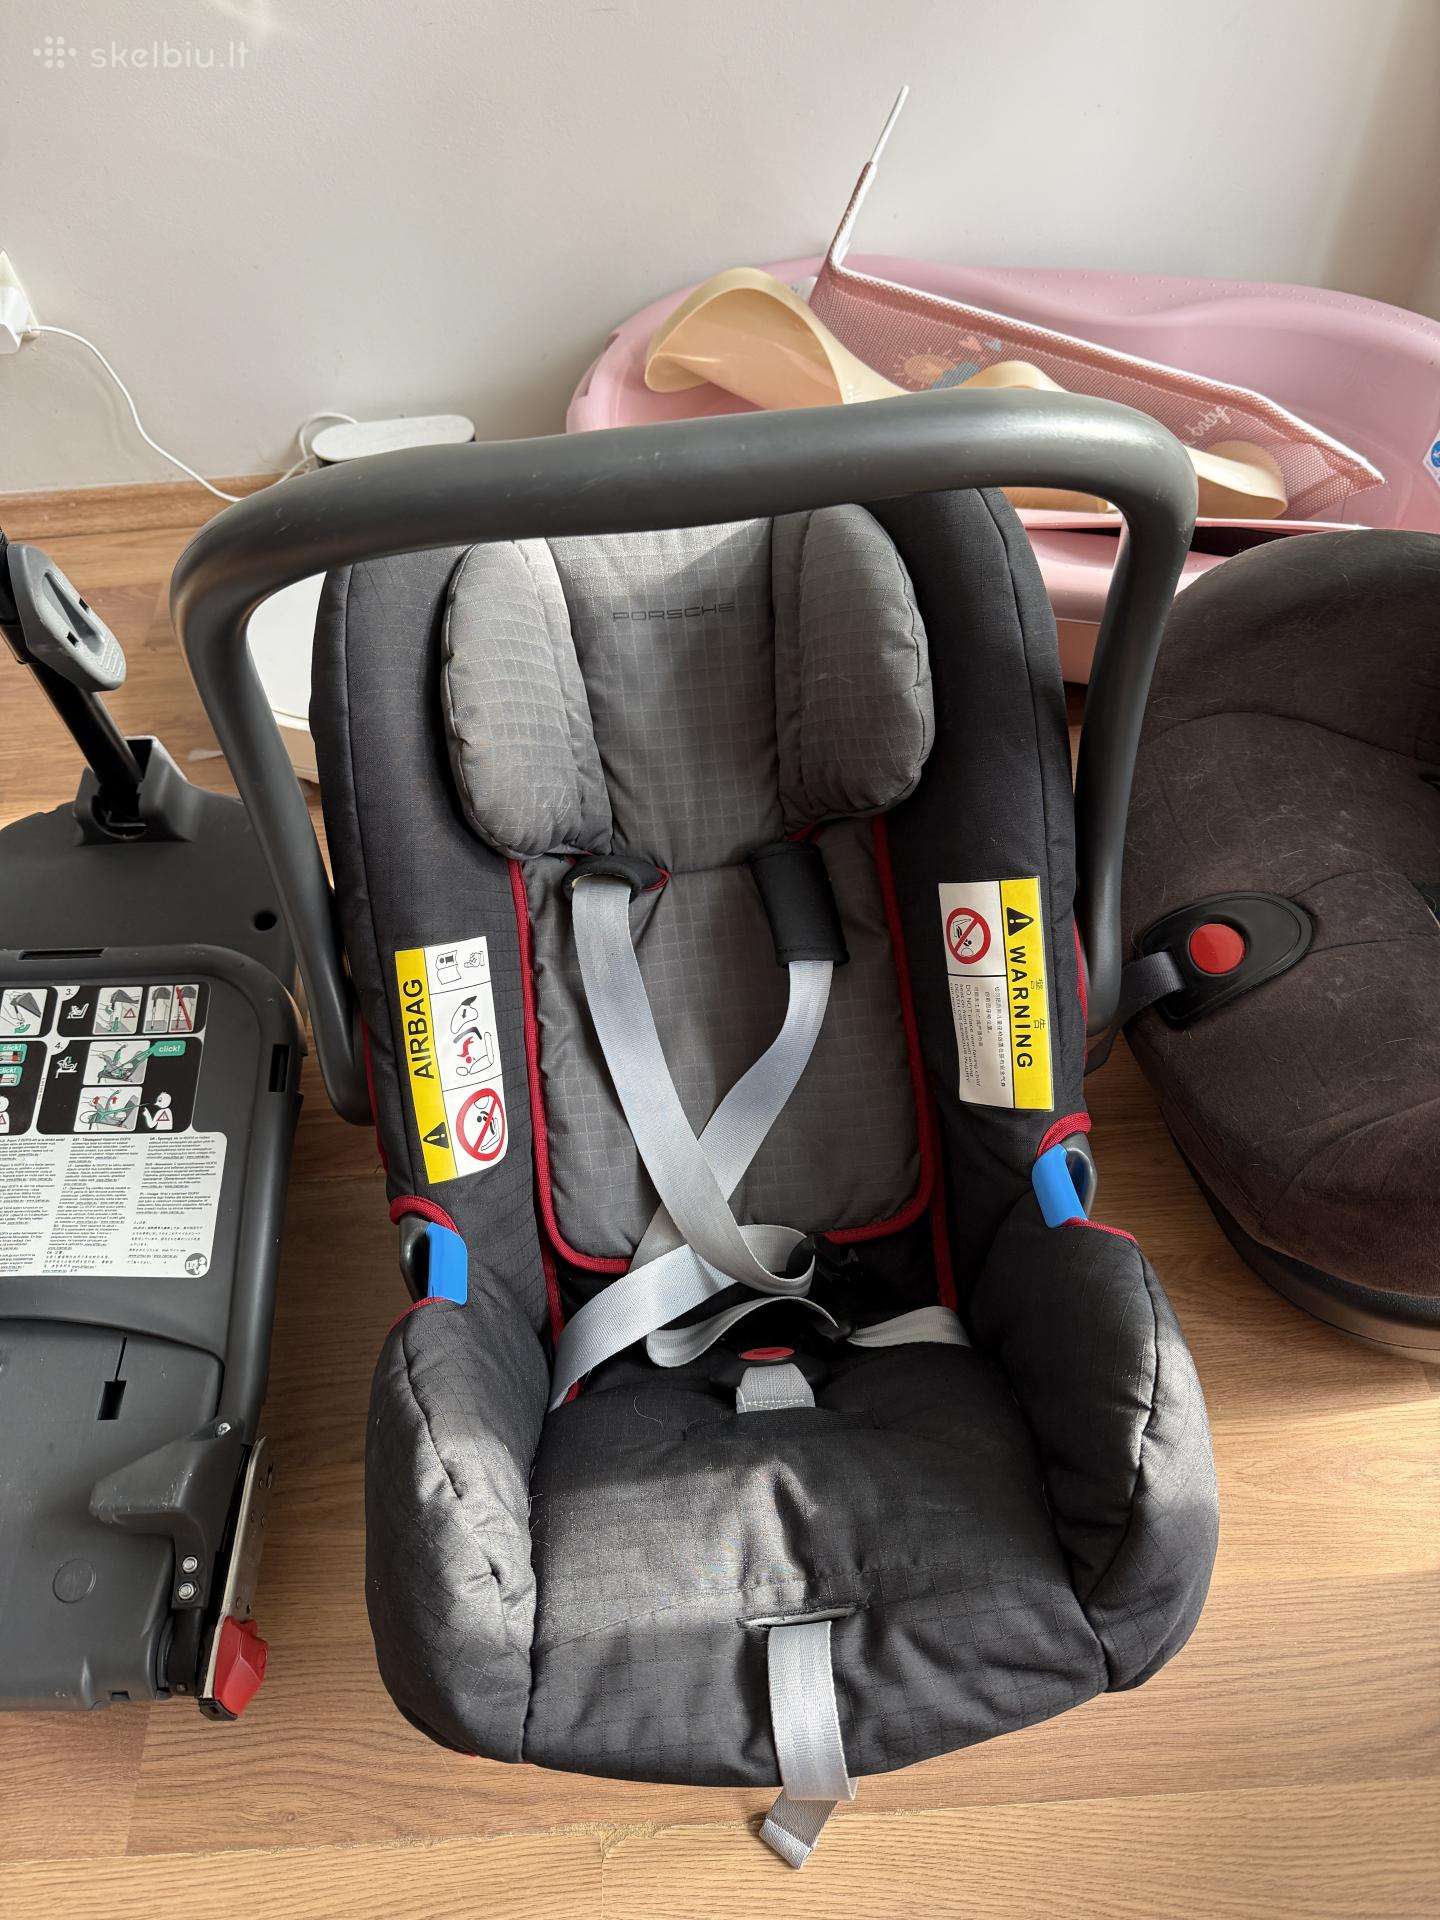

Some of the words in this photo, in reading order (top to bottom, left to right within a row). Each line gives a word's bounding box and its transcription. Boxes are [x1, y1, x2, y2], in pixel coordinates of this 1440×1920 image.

[1184, 404, 1232, 437] baby
[612, 602, 736, 621] PORSCHE
[402, 979, 435, 1080] AIRBAG
[1009, 945, 1033, 1068] WARNING
